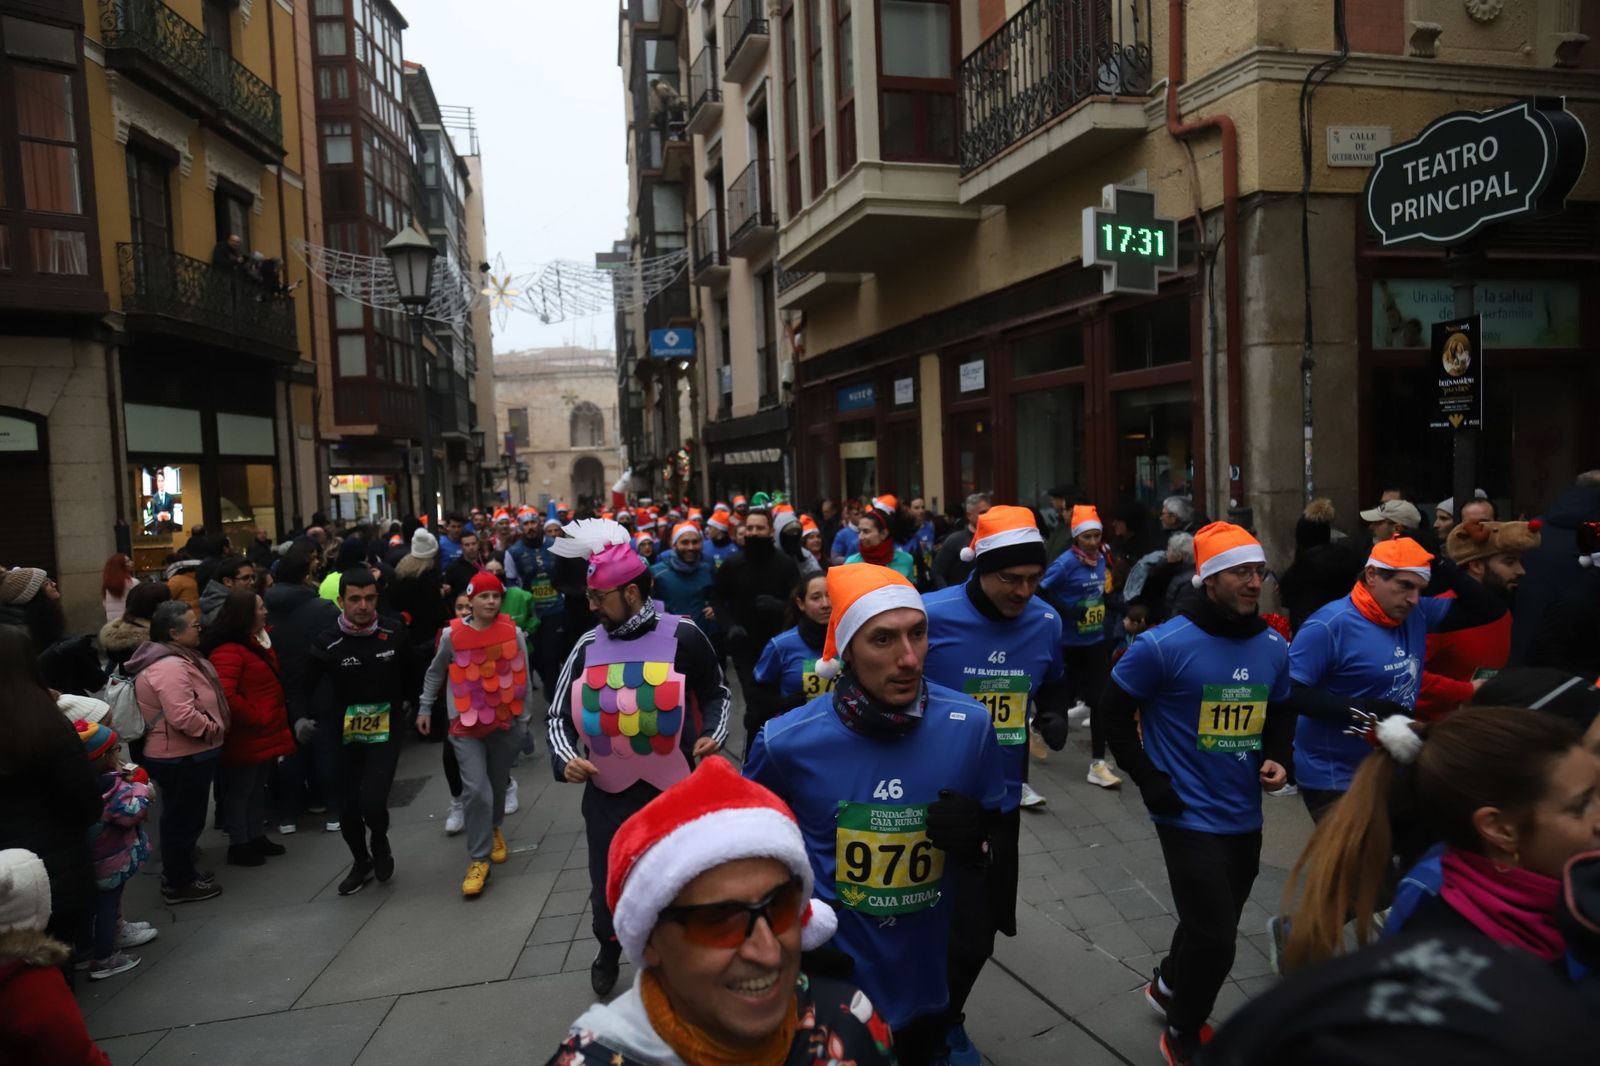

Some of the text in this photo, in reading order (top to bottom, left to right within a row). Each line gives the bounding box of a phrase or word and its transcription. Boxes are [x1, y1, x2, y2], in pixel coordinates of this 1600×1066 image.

[1350, 132, 1377, 141] CALLE
[1355, 143, 1367, 151] DE
[1331, 153, 1375, 161] QUEBRANTAHU
[1402, 136, 1499, 186] TEATRO
[1390, 171, 1518, 226] PRINCIPAL
[1102, 224, 1164, 256] 17:31
[1412, 290, 1428, 304] Un
[1484, 288, 1497, 304] la
[1499, 287, 1533, 304] salud
[1439, 308, 1452, 320] de
[987, 650, 1007, 664] 46
[977, 668, 1009, 676] SILVESTRE
[1232, 668, 1249, 681] 46
[349, 715, 381, 731] 1124
[1211, 704, 1254, 731] 1117
[996, 732, 1022, 741] RURAL
[872, 778, 904, 801] 46
[870, 817, 923, 827] CAJA RURAL
[845, 841, 932, 886] 976
[867, 888, 938, 907] CAJA RURAL
